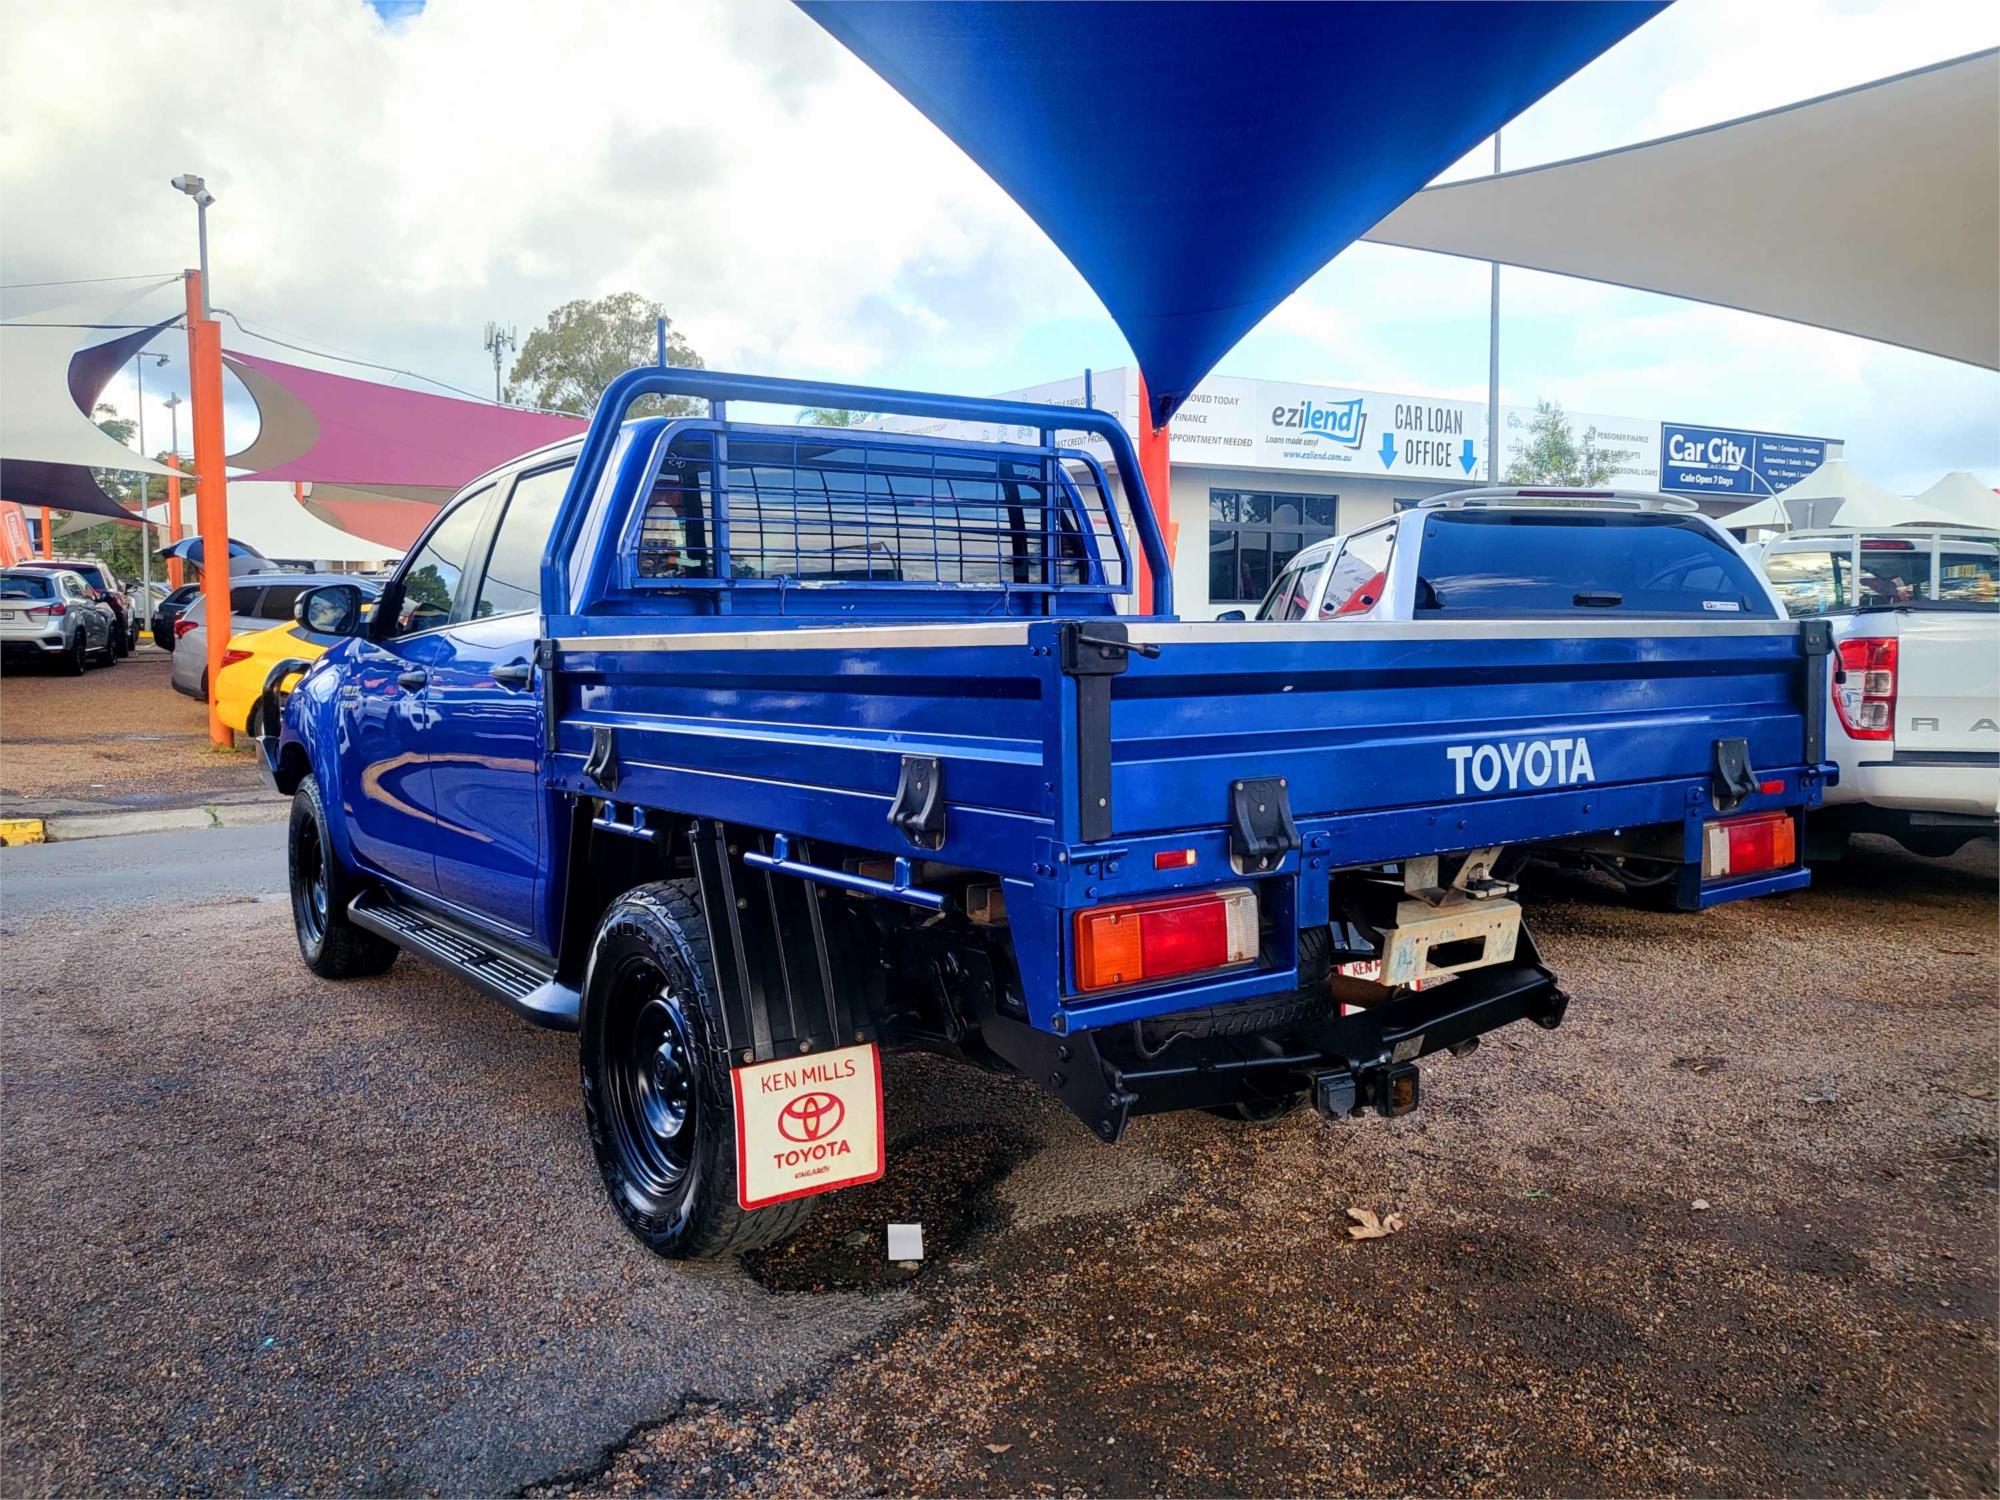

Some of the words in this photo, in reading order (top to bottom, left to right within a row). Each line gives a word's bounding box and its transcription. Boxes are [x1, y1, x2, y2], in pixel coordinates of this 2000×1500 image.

[1214, 396, 1239, 405] TODAY
[1174, 413, 1208, 424] FINANCE
[1272, 400, 1354, 432] ezilend
[1395, 404, 1423, 431] CAR
[1428, 407, 1463, 435] LOAN
[1067, 436, 1087, 447] CREDIT
[1223, 437, 1253, 447] NEEDED
[1265, 435, 1284, 443] Loans
[1285, 437, 1303, 446] made
[1627, 434, 1649, 443] FINANCE
[1283, 450, 1352, 462] www.ezilend.com.au
[1405, 439, 1452, 467] OFFICE
[1669, 434, 1705, 461] Car
[1707, 437, 1746, 465] City
[1639, 469, 1659, 477] LOANS
[1680, 473, 1694, 483] Cafe
[1695, 474, 1713, 485] Open
[1713, 476, 1718, 485] 7
[1718, 476, 1734, 487] Days
[1447, 737, 1596, 795] TOYOTA
[761, 1070, 797, 1093] KEN
[801, 1059, 856, 1086] MILLS
[773, 1139, 852, 1169] TOYOTA
